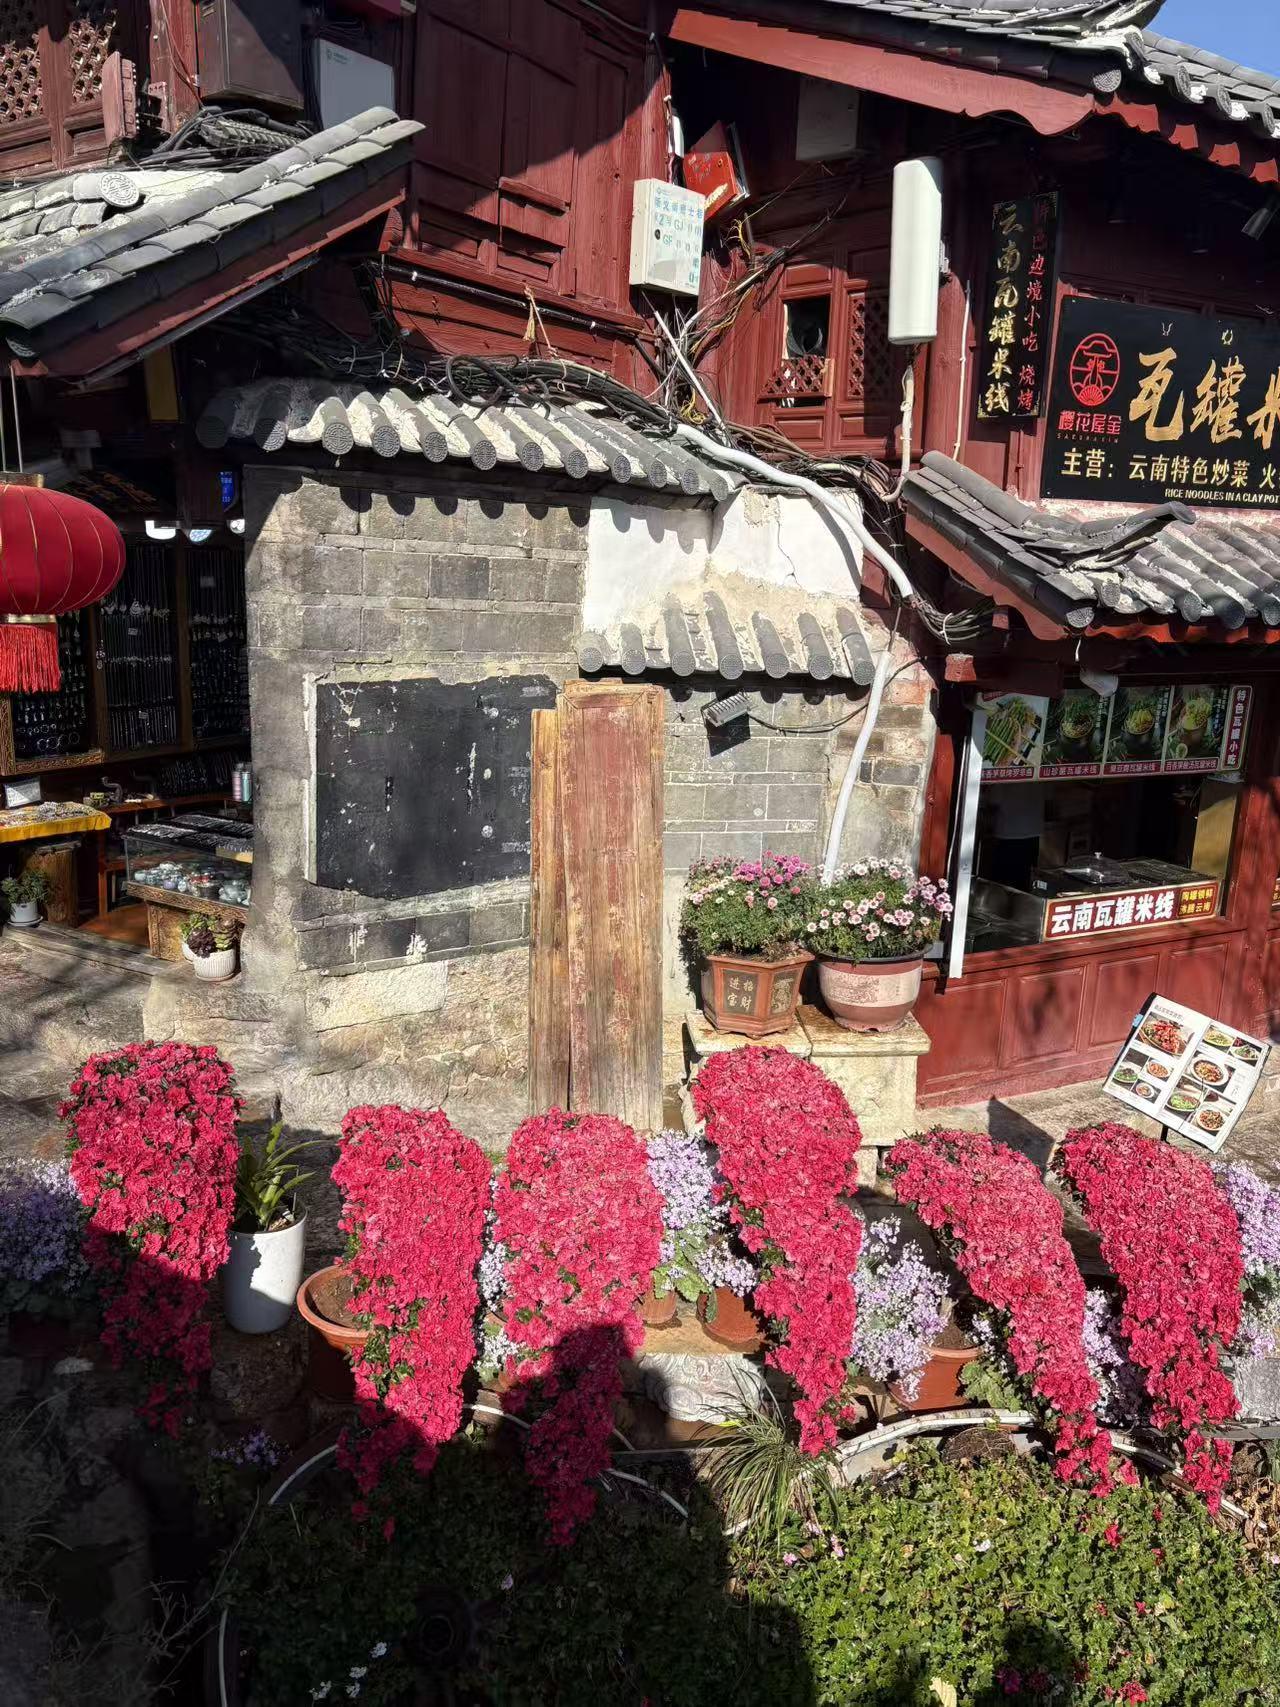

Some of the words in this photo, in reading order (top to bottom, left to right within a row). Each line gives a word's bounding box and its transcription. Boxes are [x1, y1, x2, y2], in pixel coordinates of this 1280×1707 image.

[984, 201, 1024, 413] 云南瓦罐米线
[1128, 453, 1250, 488] 云南特色炒菜
[1258, 462, 1280, 490] 火
[1164, 488, 1185, 499] RICE
[1185, 489, 1224, 501] NOODLES
[1051, 890, 1175, 934] 云南瓦罐米线
